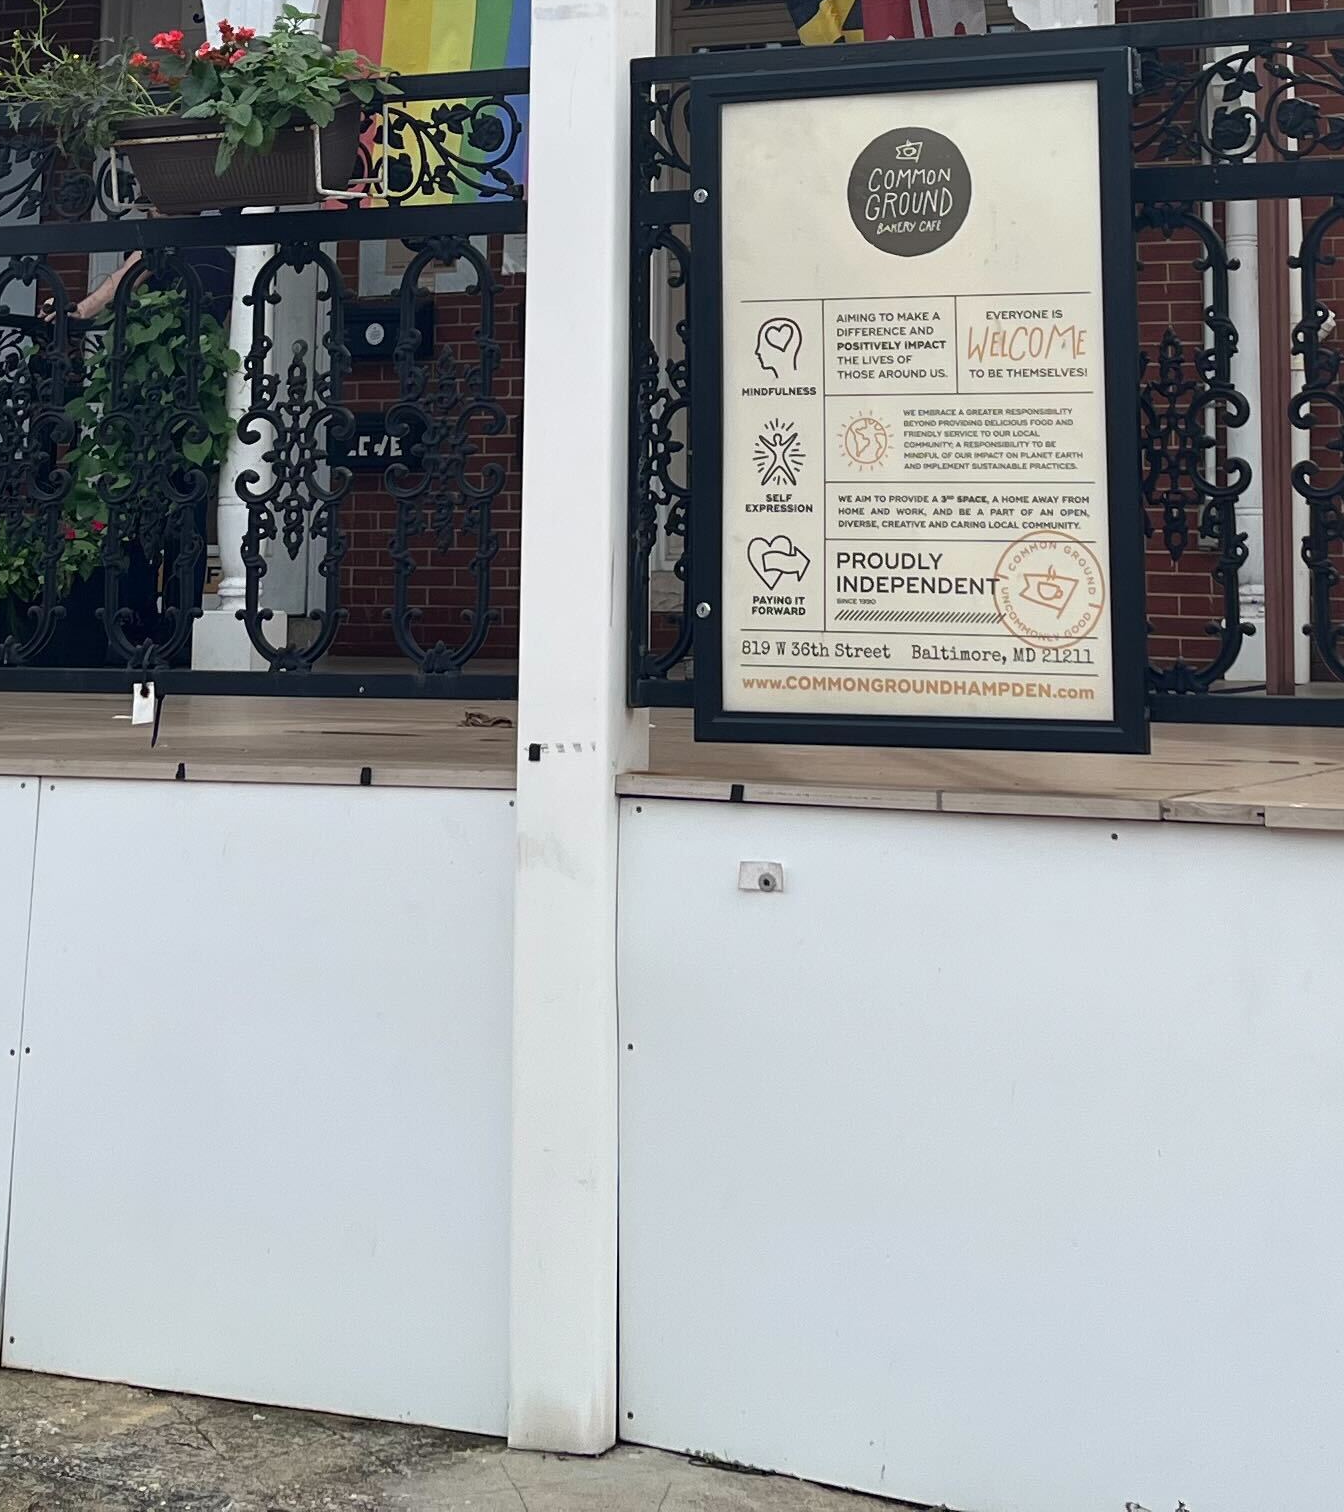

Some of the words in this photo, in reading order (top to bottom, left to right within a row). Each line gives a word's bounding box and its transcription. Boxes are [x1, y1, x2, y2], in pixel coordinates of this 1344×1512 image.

[868, 168, 951, 192] COMMON
[865, 187, 953, 220] GROUND
[877, 221, 916, 234] BAKERY
[837, 313, 876, 322] AIMING
[879, 313, 894, 321] TO
[898, 312, 929, 321] MAKE
[933, 312, 940, 320] A
[986, 310, 1048, 320] EVERYONE
[1052, 310, 1063, 318] IS
[837, 327, 906, 337] DIFFERENCE
[910, 327, 934, 335] AND
[837, 341, 901, 350] POSITIVELY
[905, 341, 946, 349] IMPACT
[968, 324, 1087, 363] WELCOME
[837, 356, 858, 364] THE
[863, 356, 894, 364] LIVES
[897, 355, 912, 364] OF
[837, 370, 874, 379] THOSE
[879, 370, 926, 378] AROUND
[930, 369, 948, 377] US.
[969, 369, 984, 378] TO
[988, 369, 1003, 377] BE
[1006, 368, 1087, 377] THEMSELVES!
[742, 387, 816, 396] MINDFULNESS
[903, 409, 916, 417] WE
[918, 408, 956, 417] EMBRACE
[959, 408, 964, 416] A
[966, 408, 1003, 416] GREATER
[1005, 407, 1072, 416] RESPONSIBILITY
[904, 419, 936, 428] BEYOND
[939, 419, 982, 427] PROVIDING
[984, 419, 1028, 427] DELICIOUS
[1030, 418, 1053, 427] FOOD
[1056, 418, 1073, 426] AND
[904, 430, 942, 438] FRIENDLY
[944, 430, 978, 438] SERVICE
[980, 430, 991, 438] TO
[993, 430, 1010, 438] OUR
[1013, 429, 1040, 438] LOCAL
[964, 440, 1029, 449] RESPONSIBILITY
[1032, 440, 1043, 448] TO
[1045, 440, 1056, 448] BE
[904, 451, 939, 460] MINDFUL
[941, 451, 953, 460] OF
[955, 451, 972, 460] OUR
[974, 451, 1003, 459] IMPACT
[1006, 451, 1018, 459] ON
[1021, 451, 1052, 459] PLANET
[1055, 451, 1083, 459] EARTH
[904, 462, 921, 470] AND
[923, 462, 969, 470] IMPLEMENT
[972, 462, 1027, 470] SUSTAINABLE
[766, 494, 792, 502] SELF
[839, 495, 852, 503] WE
[855, 495, 871, 503] AIM
[874, 495, 886, 503] TO
[889, 495, 929, 504] PROVIDE
[932, 495, 938, 503] A
[992, 495, 999, 504] A
[1002, 495, 1029, 504] HOME
[1032, 495, 1058, 504] AWAY
[1062, 495, 1089, 504] FROM
[746, 504, 812, 512] EXPRESSION
[839, 507, 864, 516] HOME
[871, 507, 890, 516] AND
[896, 508, 926, 516] WORK,
[933, 507, 953, 516] AND
[959, 507, 971, 516] BE
[977, 508, 984, 516] A
[990, 508, 1014, 517] PART
[1021, 508, 1033, 517] OF
[1040, 508, 1053, 517] AN
[1060, 509, 1089, 517] OPEN,
[839, 520, 879, 528] DIVERSE,
[882, 520, 926, 529] CREATIVE
[929, 520, 948, 529] AND
[951, 520, 986, 529] CARING
[989, 520, 1019, 529] LOCAL
[837, 552, 942, 569] PROUDLY
[1008, 541, 1057, 571] COMMON
[1063, 546, 1096, 595] GROUND
[837, 577, 999, 595] INDEPENDENT
[752, 596, 793, 605] PAYING
[795, 597, 805, 605] IT
[837, 597, 857, 605] SINCE
[752, 606, 805, 615] FORWARD
[1064, 612, 1091, 638] GOOD
[742, 640, 770, 655] 819
[776, 642, 786, 655] W
[792, 642, 829, 657] 36th
[835, 644, 890, 658] Street
[912, 645, 1006, 665] Baltimore,
[1013, 646, 1038, 662] MD
[1040, 646, 1094, 664] 21211
[742, 674, 1097, 699] www.COMMONGROUNDHAMPDEN.com
